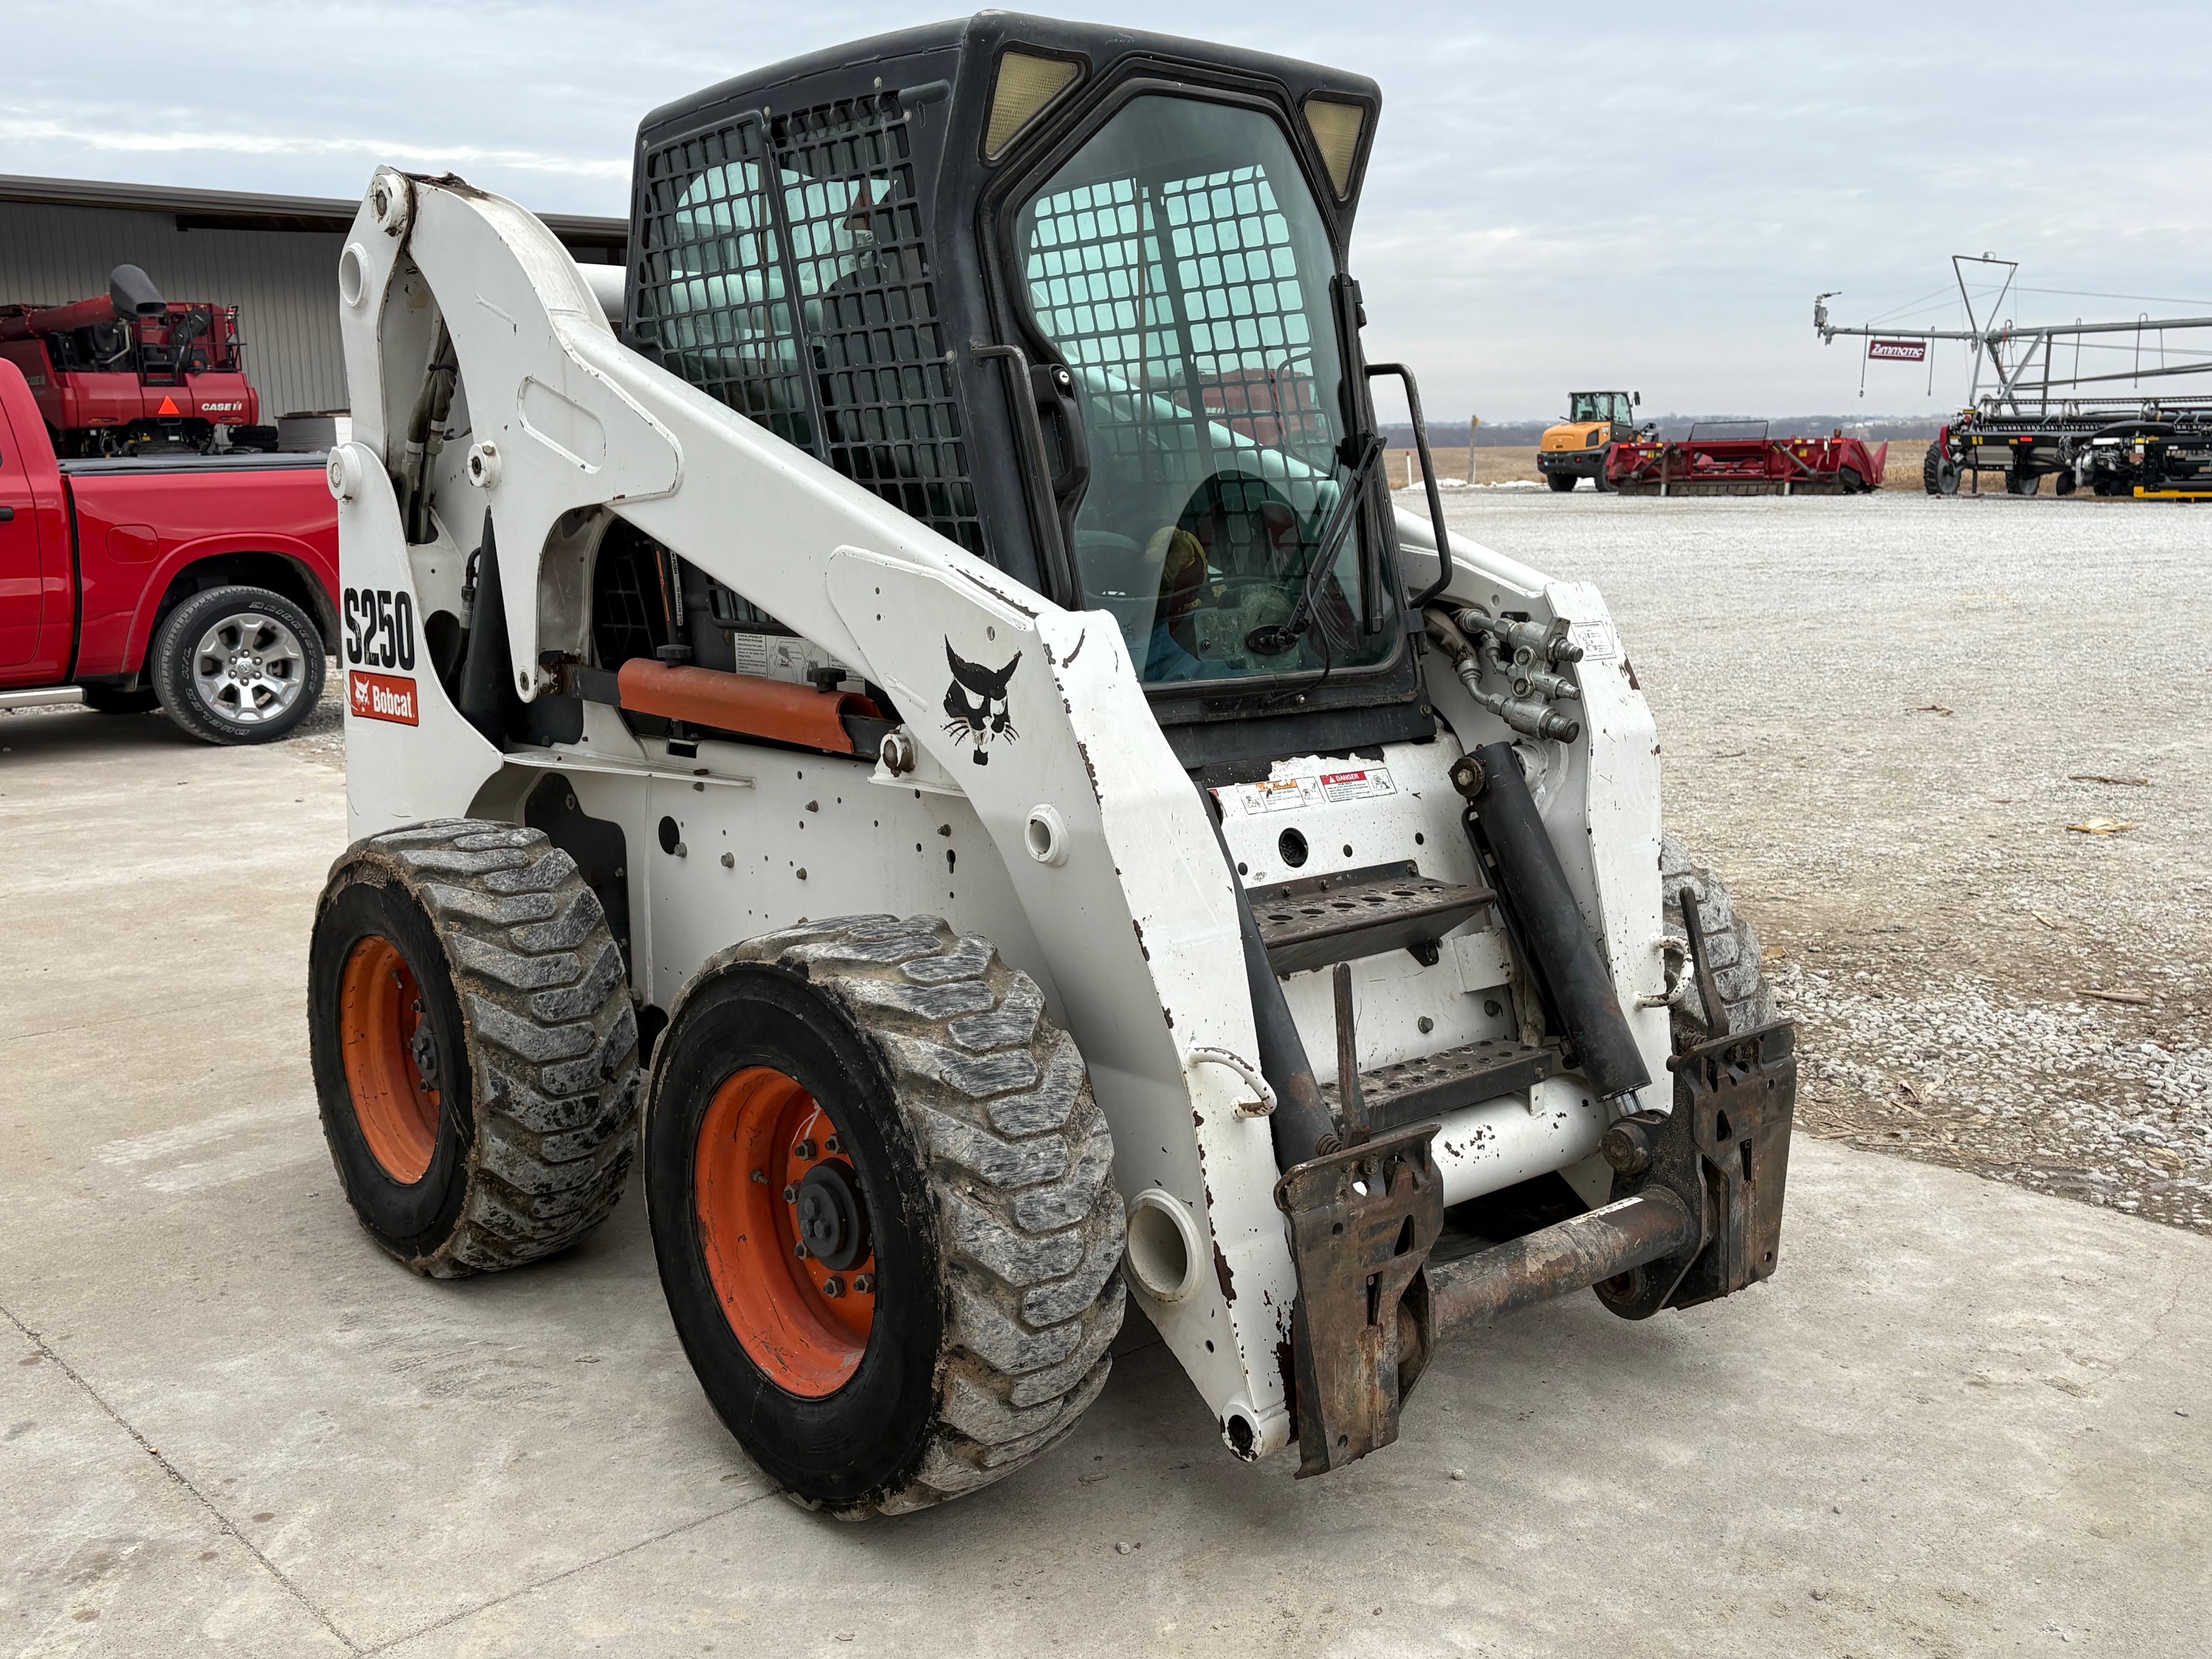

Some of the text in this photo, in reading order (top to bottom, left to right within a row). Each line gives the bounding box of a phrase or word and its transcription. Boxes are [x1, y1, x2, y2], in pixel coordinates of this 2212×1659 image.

[201, 403, 232, 411] CASE
[344, 587, 415, 671] S250
[373, 685, 414, 719] Bobcat
[1335, 773, 1359, 782] DANGER
